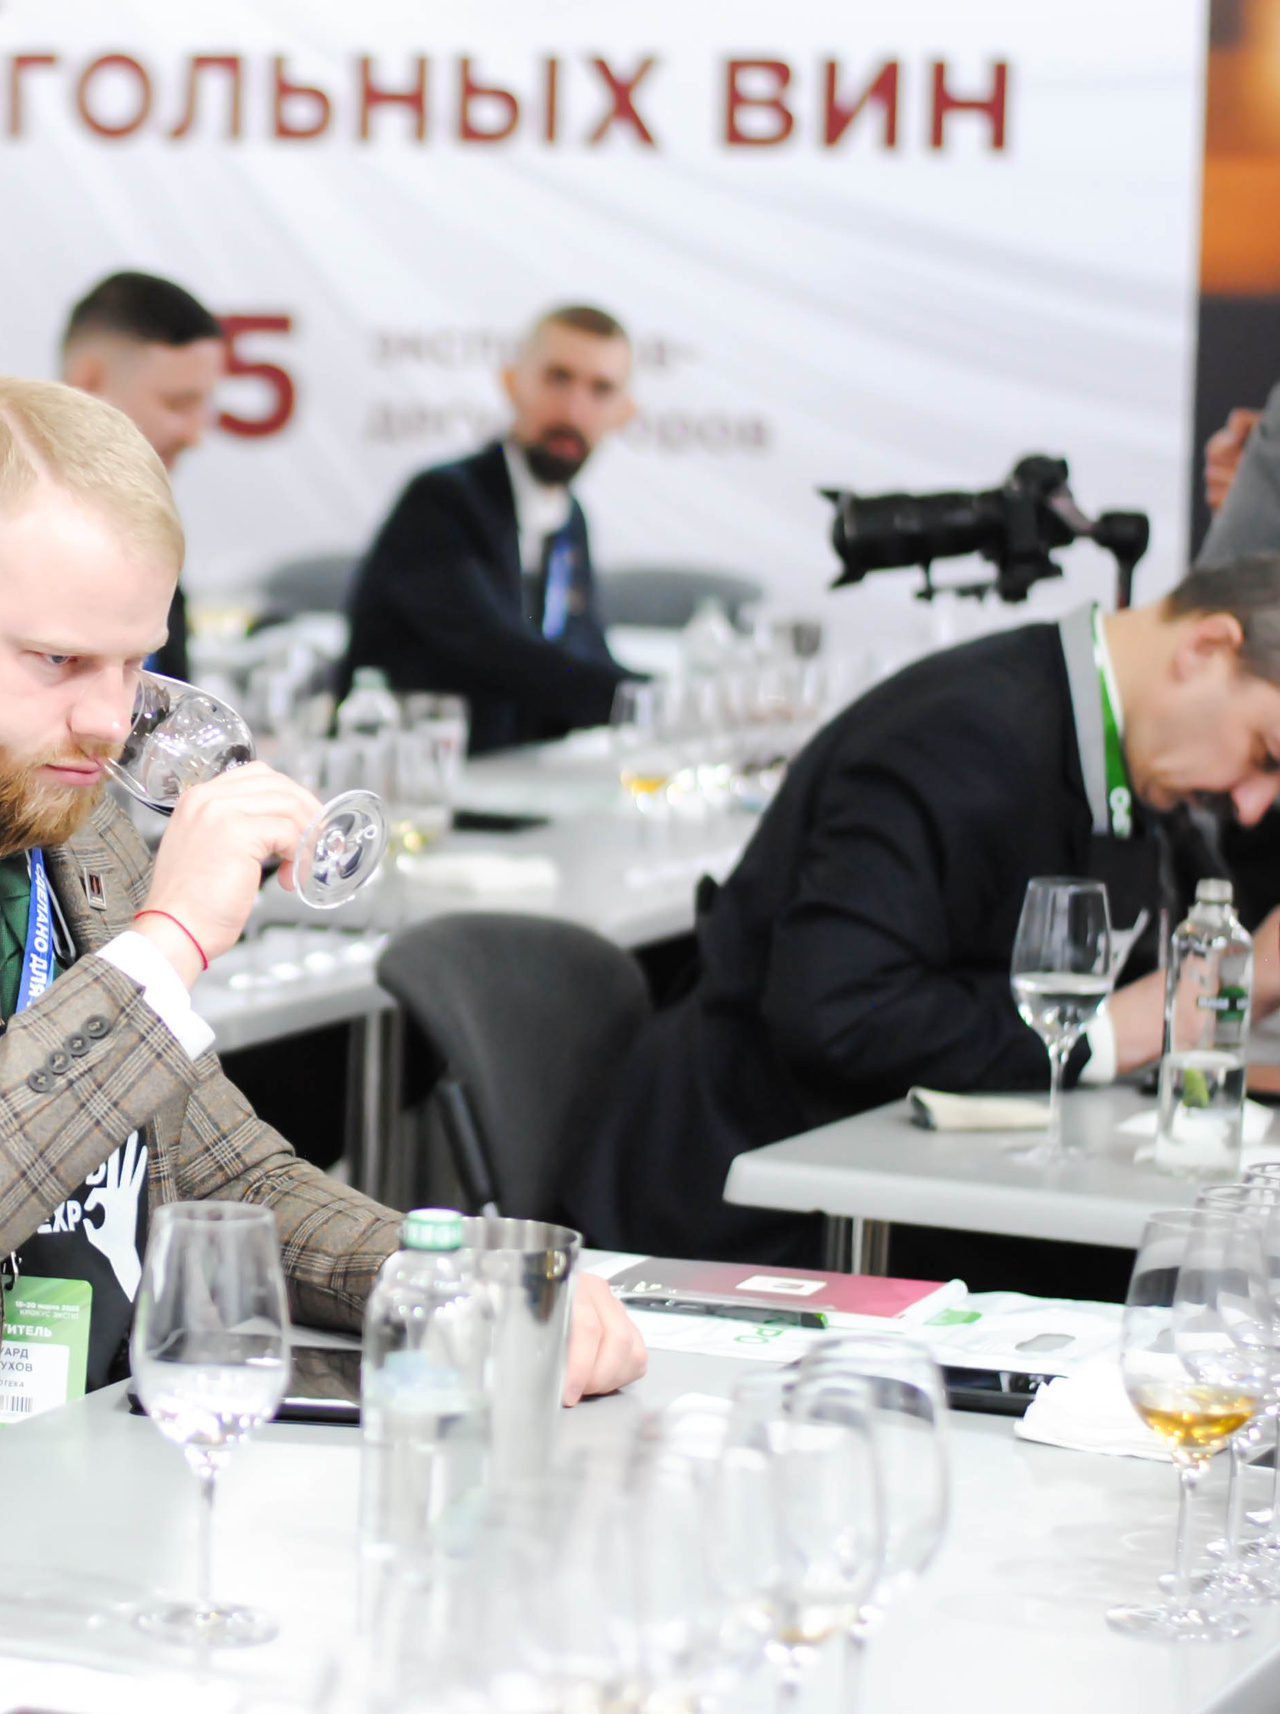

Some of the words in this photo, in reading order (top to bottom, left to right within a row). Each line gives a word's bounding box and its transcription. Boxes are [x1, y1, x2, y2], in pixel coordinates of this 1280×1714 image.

[721, 57, 1013, 152] ВИН
[33, 862, 49, 953] СДЕЛАНО
[28, 953, 48, 997] ДЛЯ
[19, 1309, 51, 1318] КРОКУС
